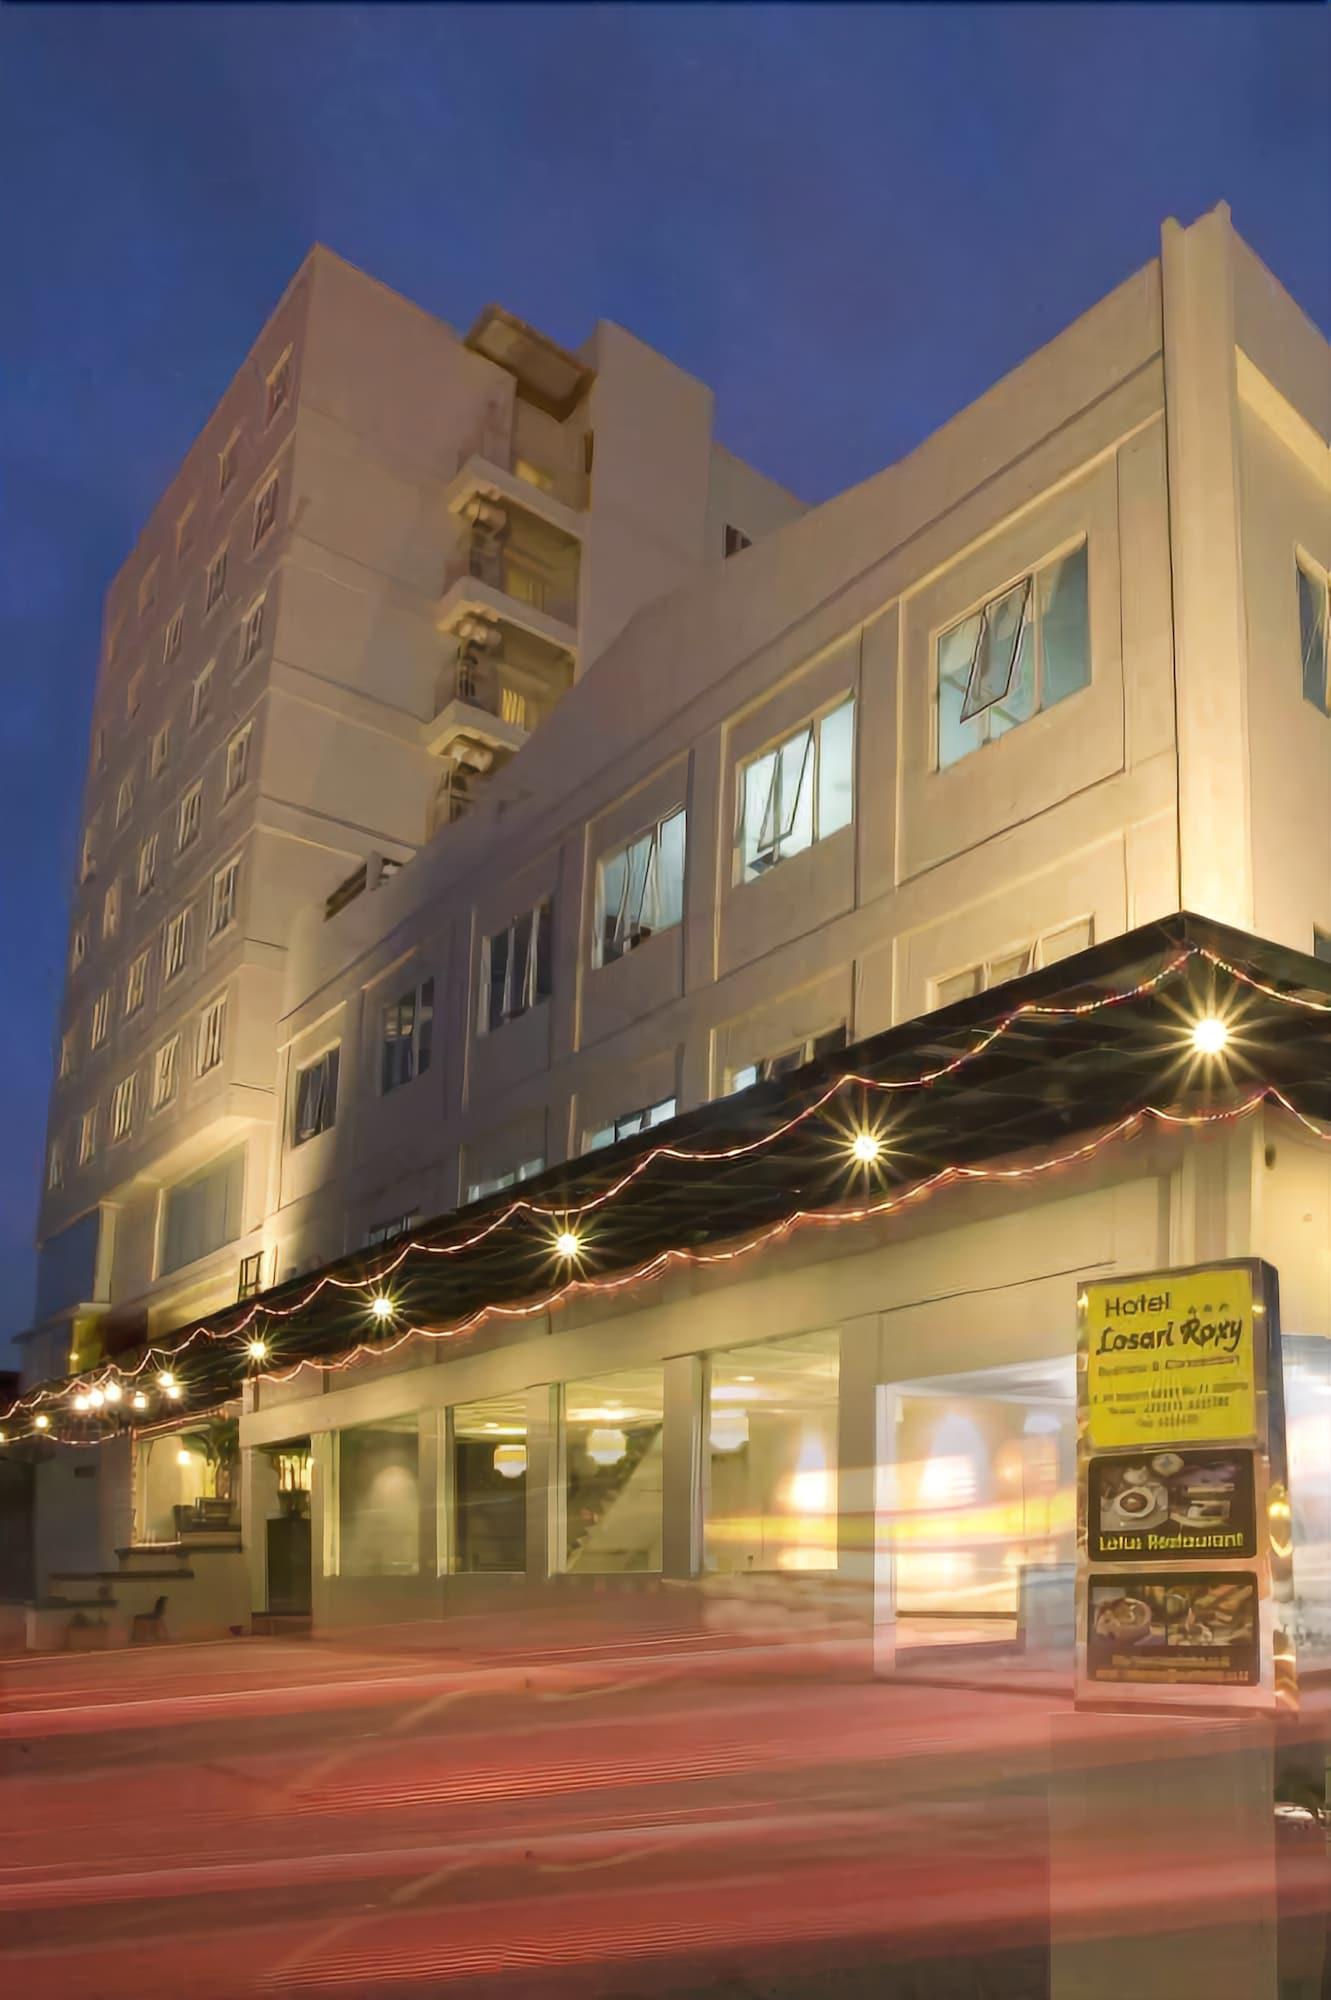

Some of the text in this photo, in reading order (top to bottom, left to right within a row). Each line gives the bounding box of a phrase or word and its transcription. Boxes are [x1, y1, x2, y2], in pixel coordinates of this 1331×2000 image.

[1105, 1291, 1170, 1318] Hotel
[1096, 1317, 1243, 1355] Losari Roxy
[1147, 1532, 1244, 1550] Restaurant
